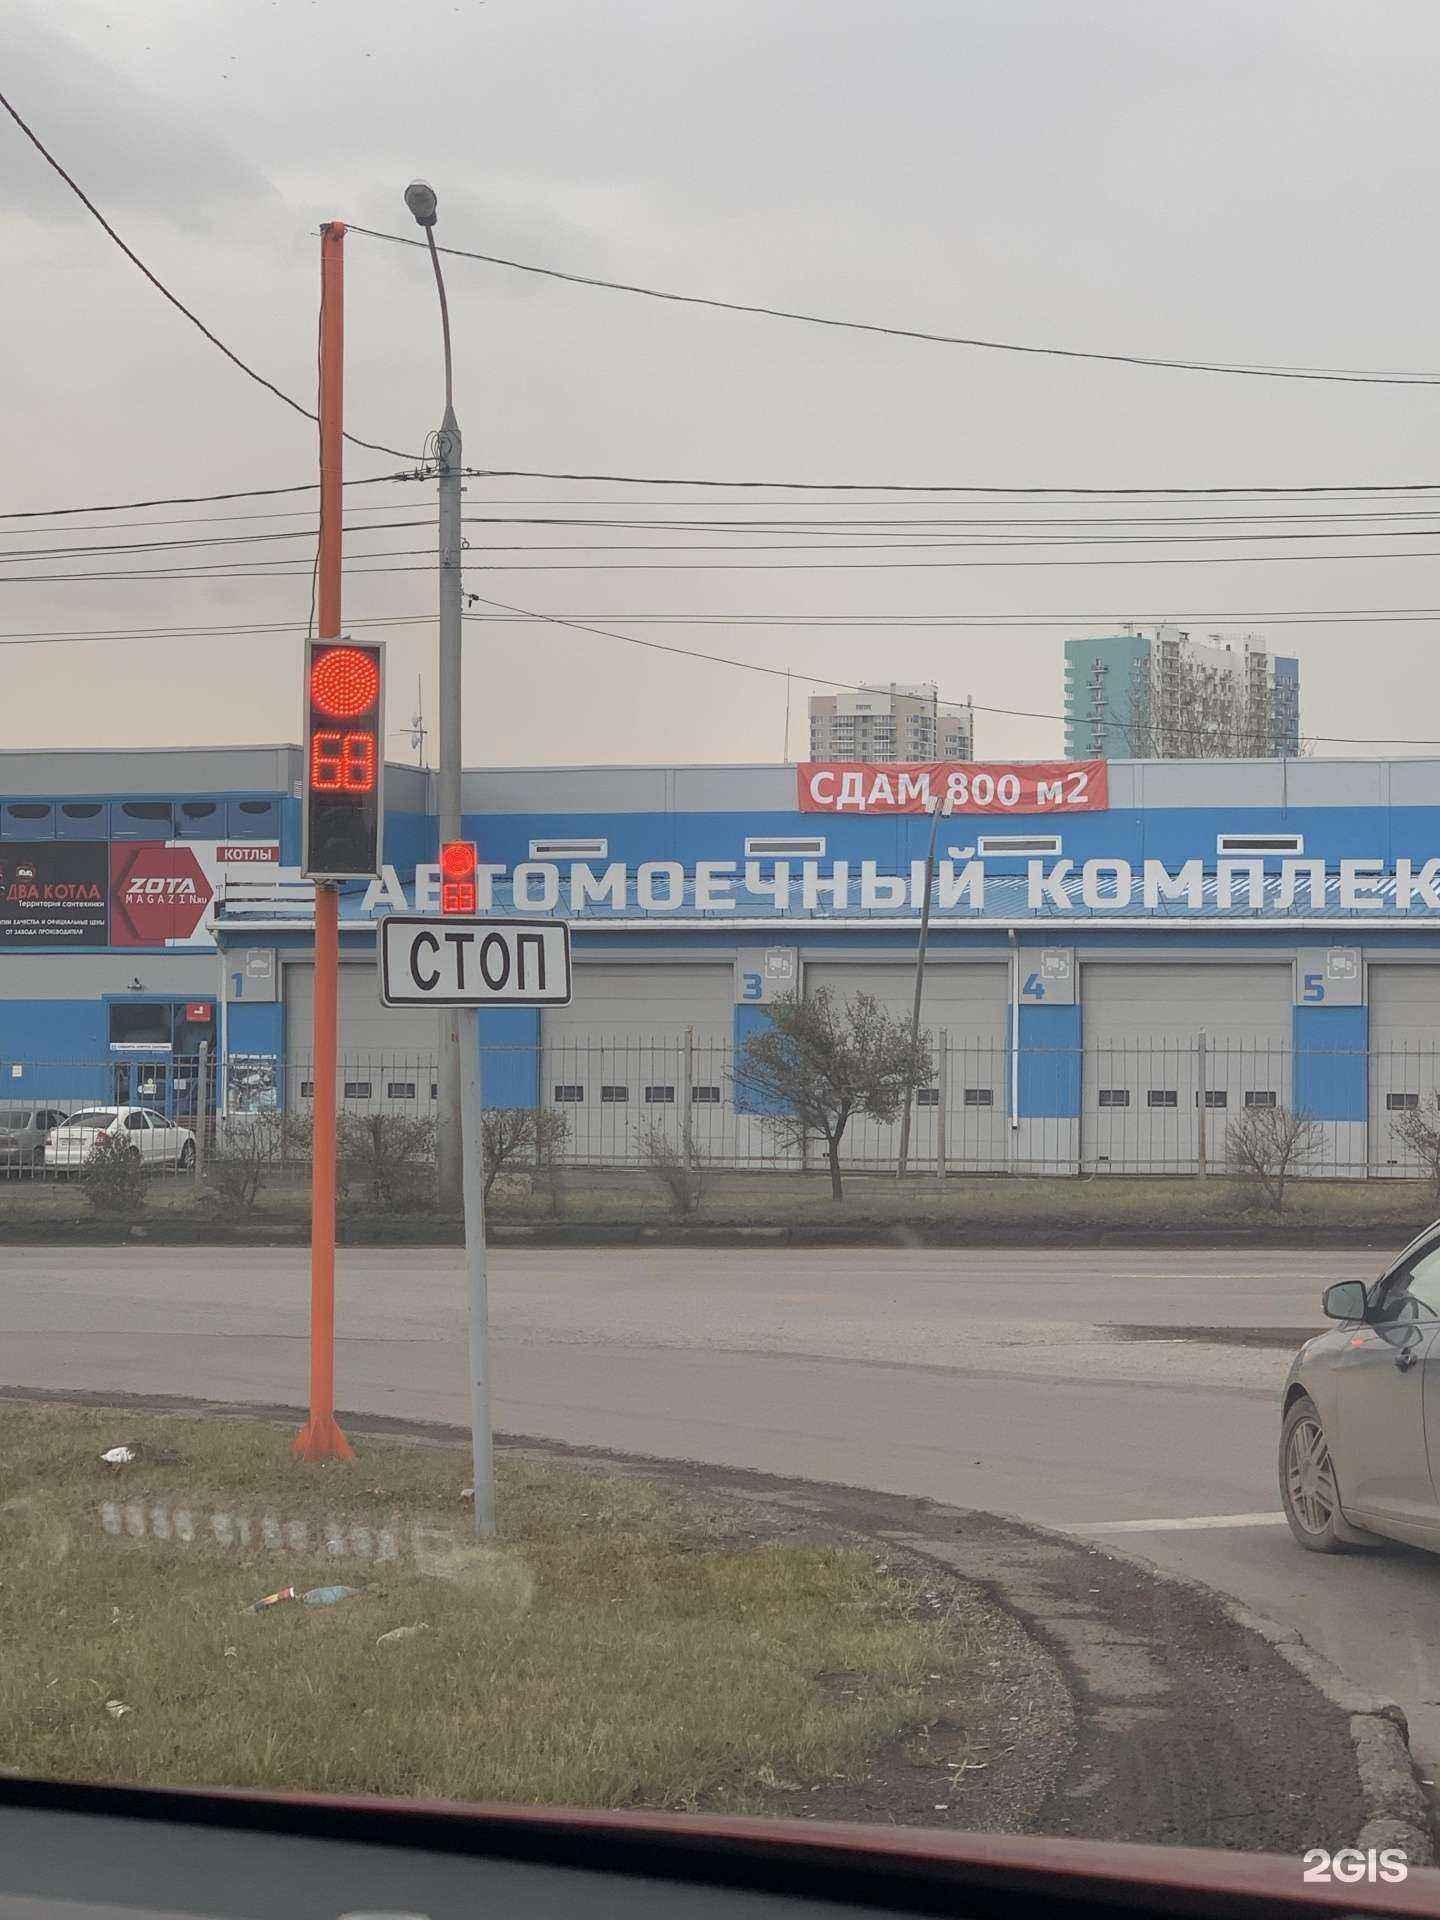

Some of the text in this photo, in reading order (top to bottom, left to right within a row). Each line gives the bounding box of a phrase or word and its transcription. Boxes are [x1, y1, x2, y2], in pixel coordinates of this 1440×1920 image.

[810, 771, 1089, 810] СДАМ 800 м2
[224, 848, 272, 861] КОТЛЫ
[7, 884, 101, 901] ДВА КОТЛА
[127, 878, 196, 894] ZOTA
[410, 931, 546, 992] СТОП
[231, 972, 244, 998] 1
[743, 974, 762, 1000] 3
[1022, 973, 1046, 1000] 4
[1303, 974, 1325, 1001] 5
